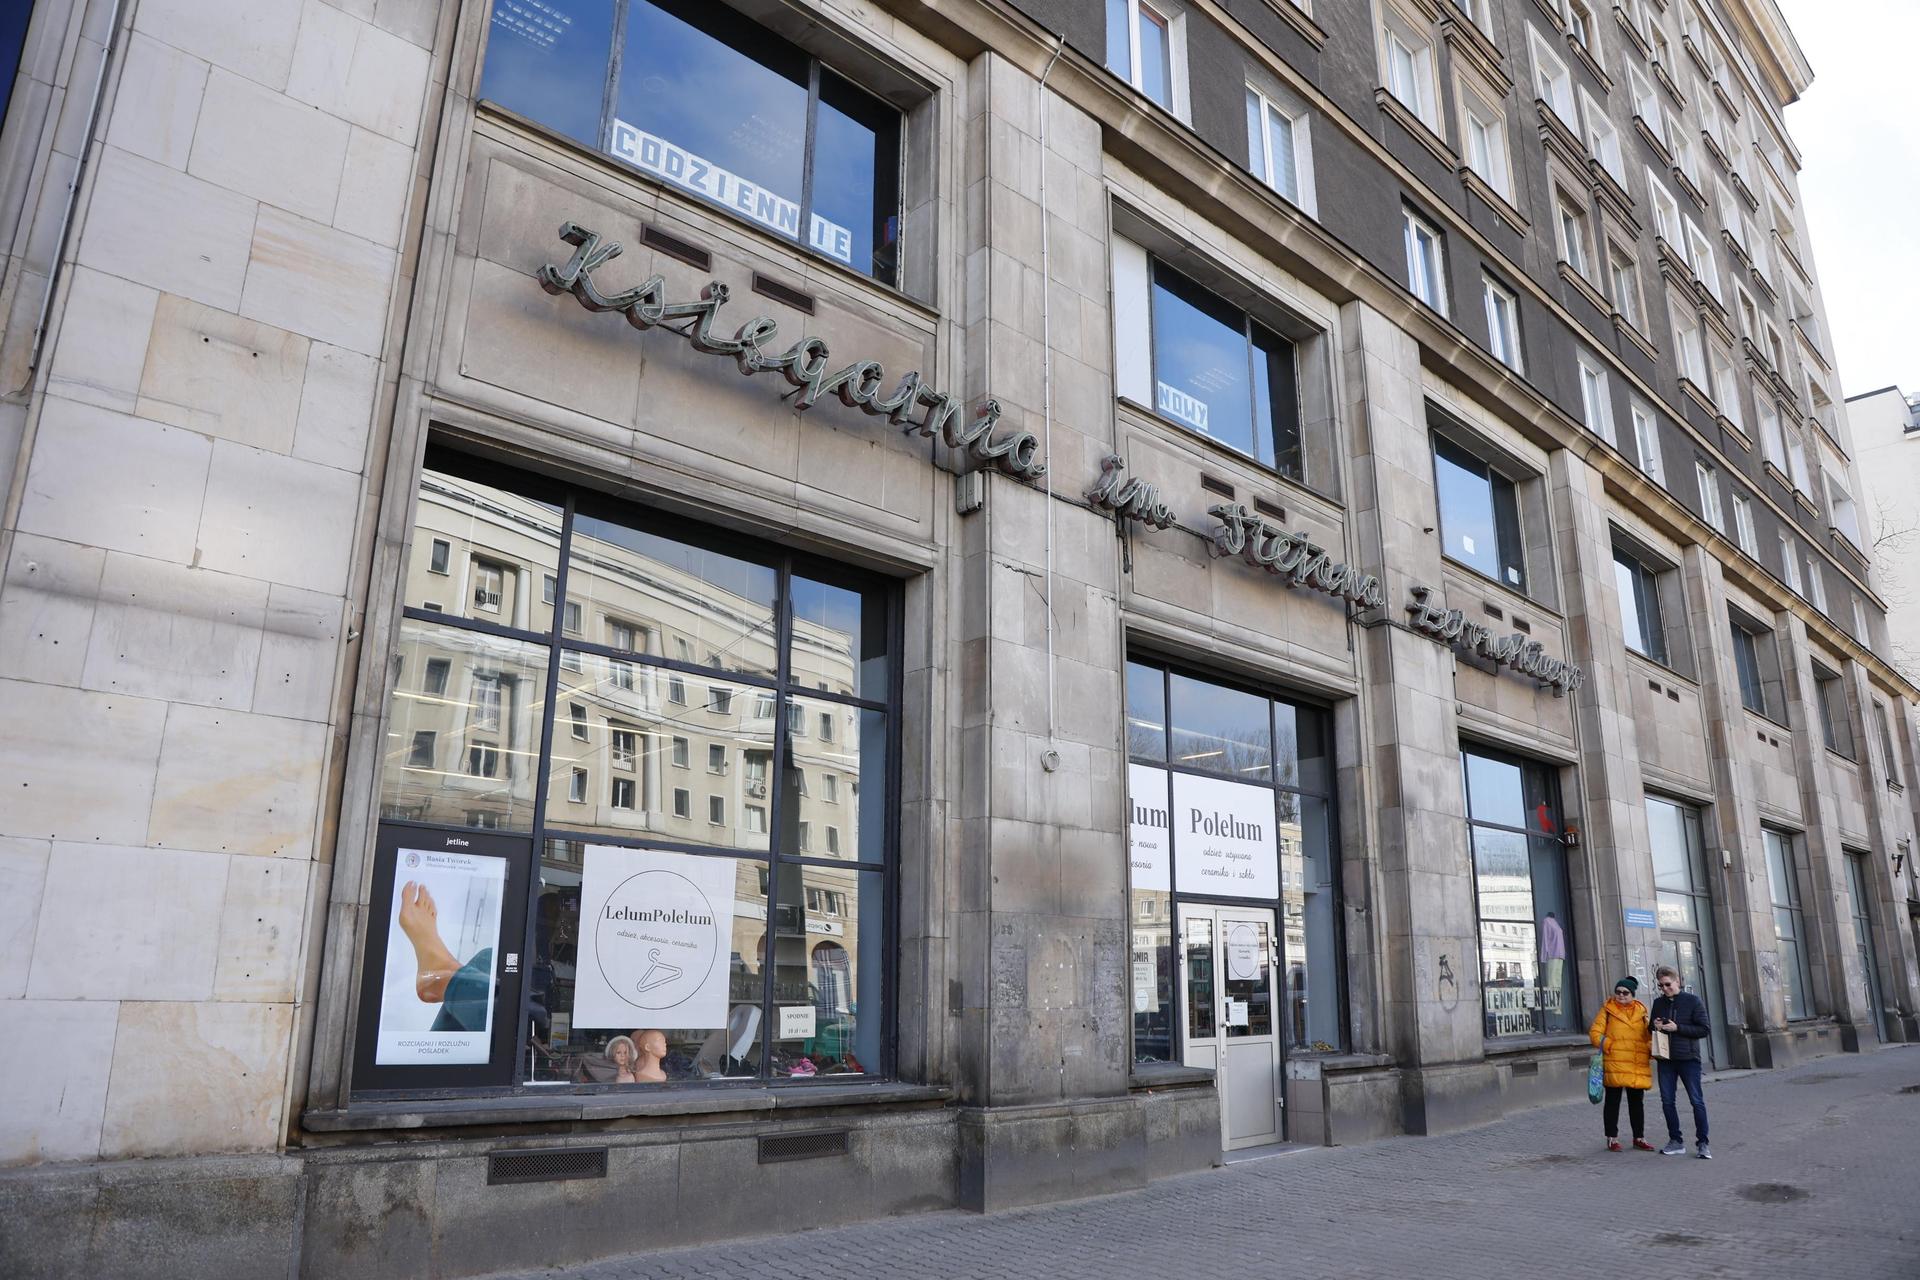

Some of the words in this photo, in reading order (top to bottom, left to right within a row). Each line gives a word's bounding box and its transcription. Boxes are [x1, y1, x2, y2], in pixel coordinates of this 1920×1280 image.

[615, 125, 849, 257] CODZIENNIE
[1160, 385, 1207, 425] NOWY
[1208, 503, 1385, 609] Stefana
[1190, 808, 1263, 841] Polelum
[446, 837, 470, 847] jetline
[1201, 866, 1229, 878] ceramika
[606, 905, 712, 926] LelumPolelum
[1497, 1013, 1532, 1034] TOWAR
